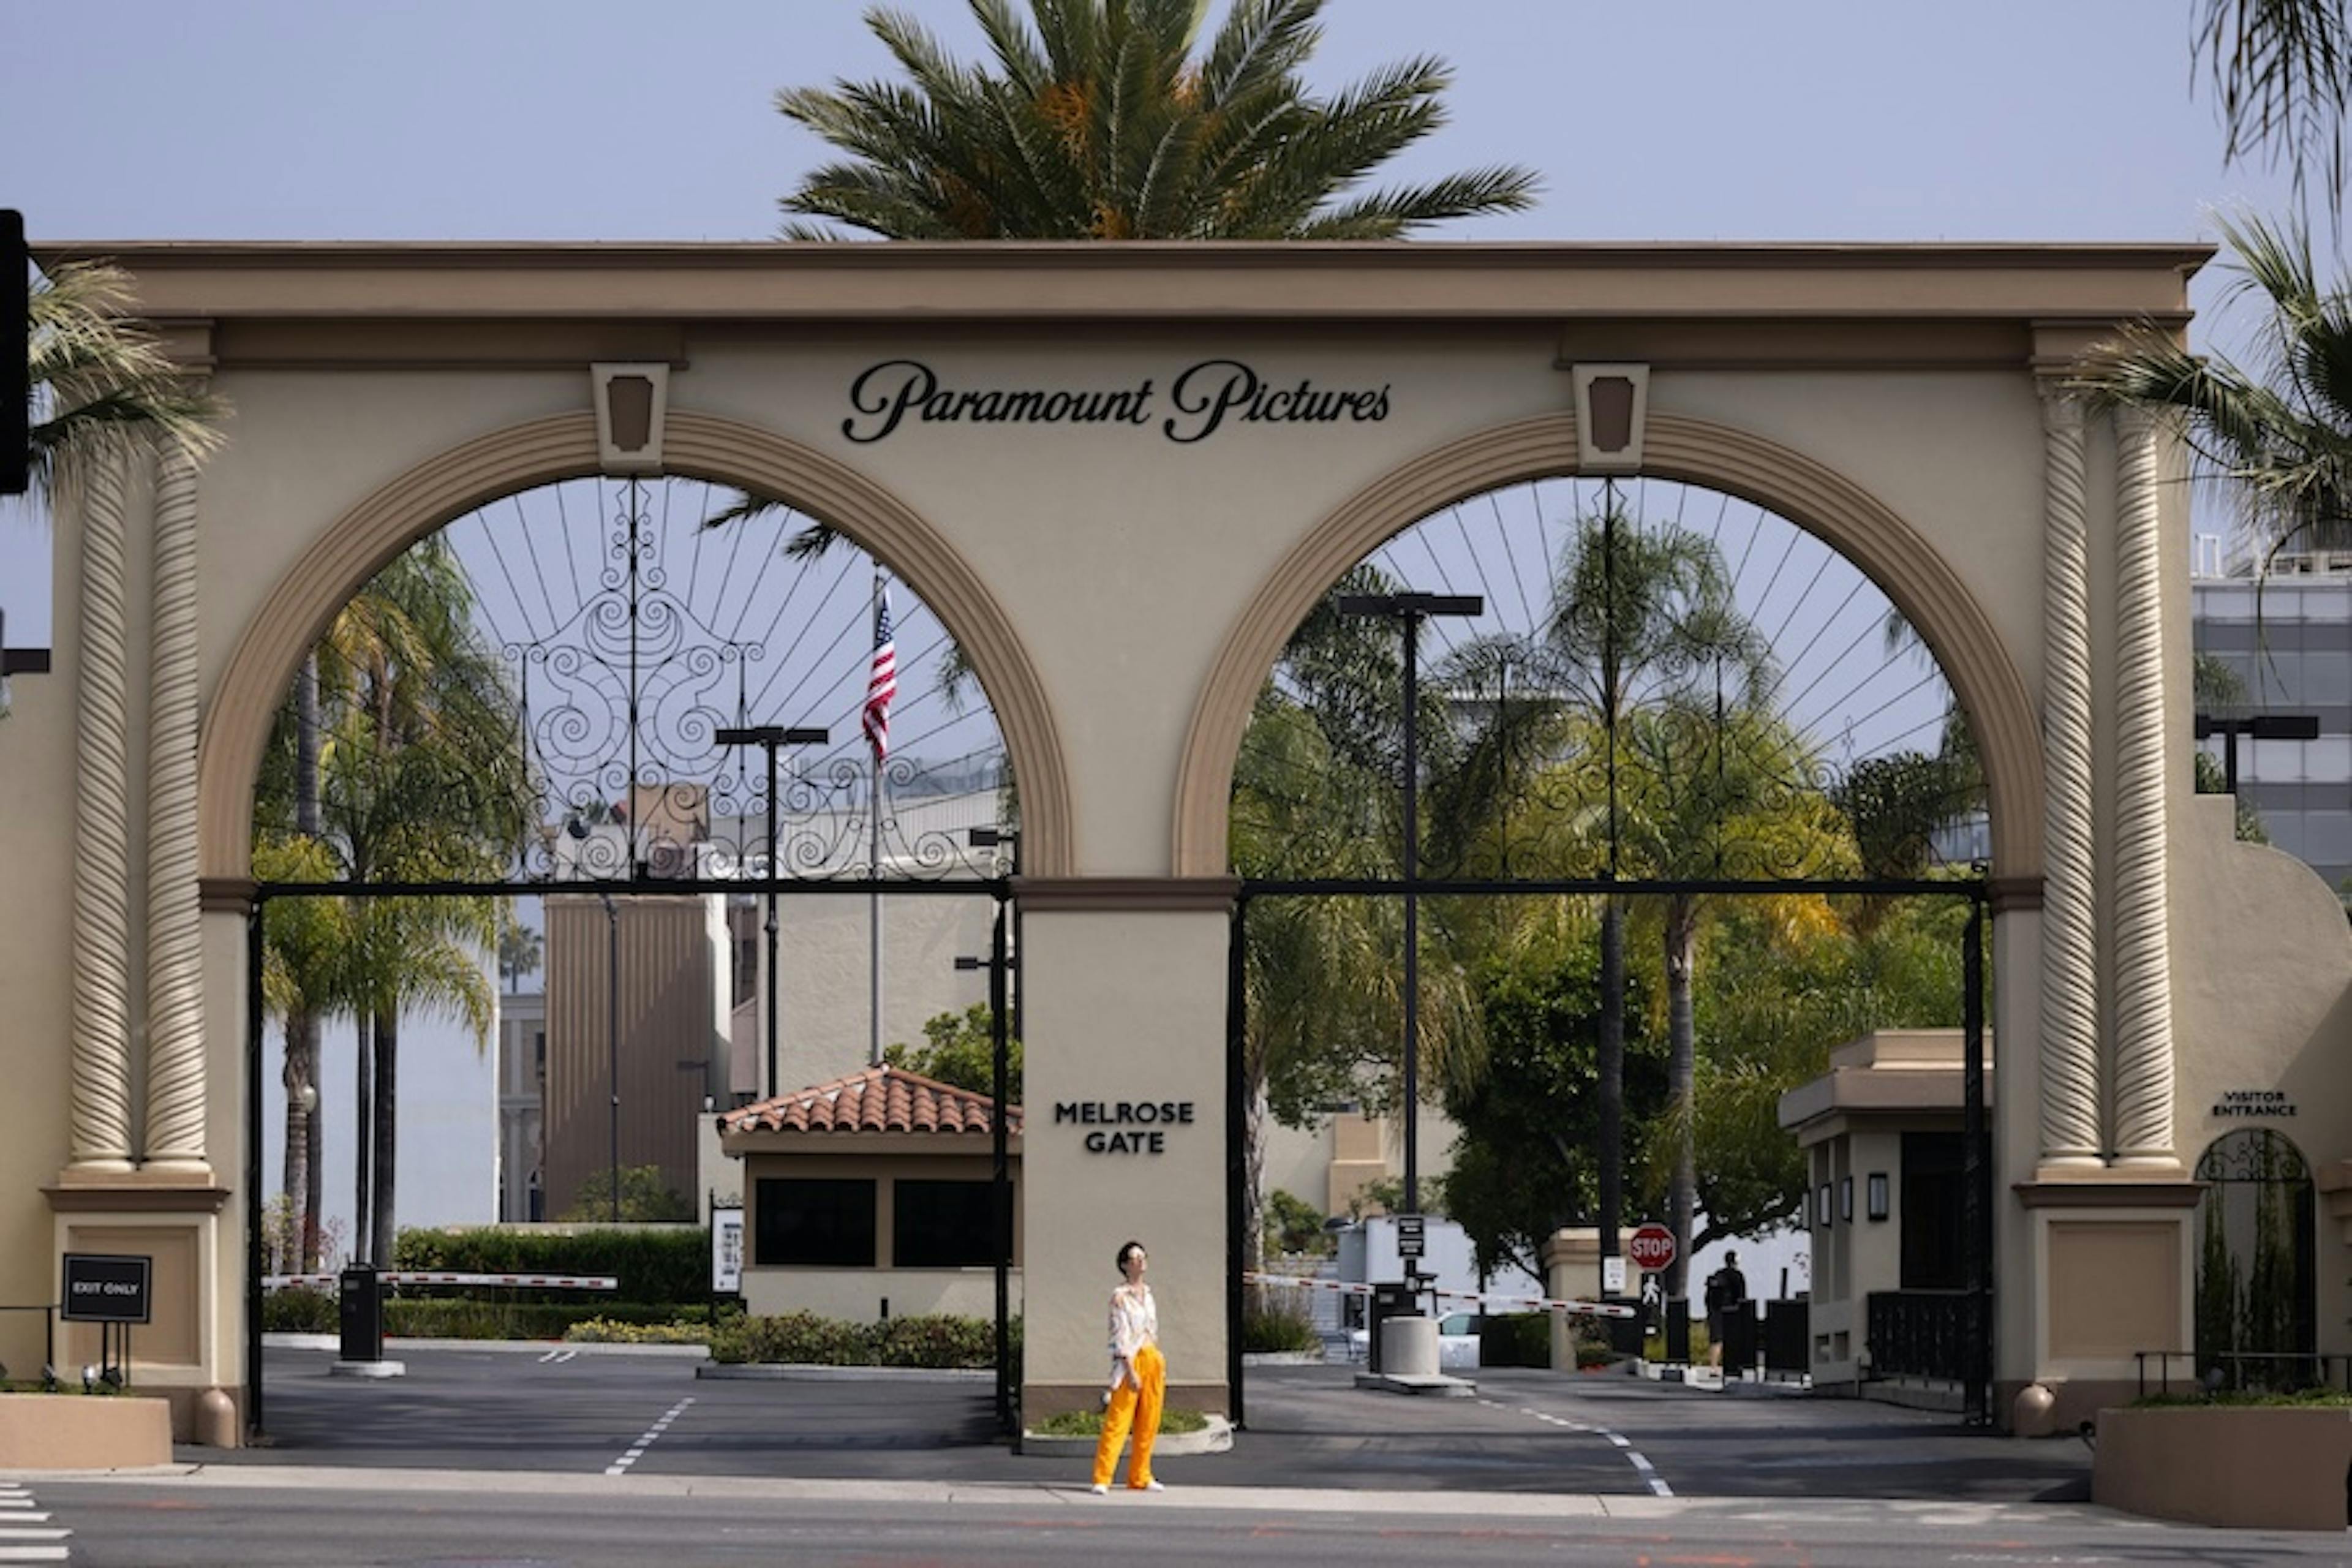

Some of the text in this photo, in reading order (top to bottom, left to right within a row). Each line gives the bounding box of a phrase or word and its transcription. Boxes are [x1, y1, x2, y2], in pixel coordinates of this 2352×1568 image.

[842, 360, 1391, 443] Paramount Pictures
[2224, 1091, 2285, 1102] VISITOR
[1055, 1102, 1194, 1125] MELROSE
[2212, 1105, 2297, 1117] ENTRANCE
[1085, 1131, 1164, 1154] GATE
[1632, 1238, 1672, 1257] STOP
[72, 1281, 139, 1295] EXIT ONLY
